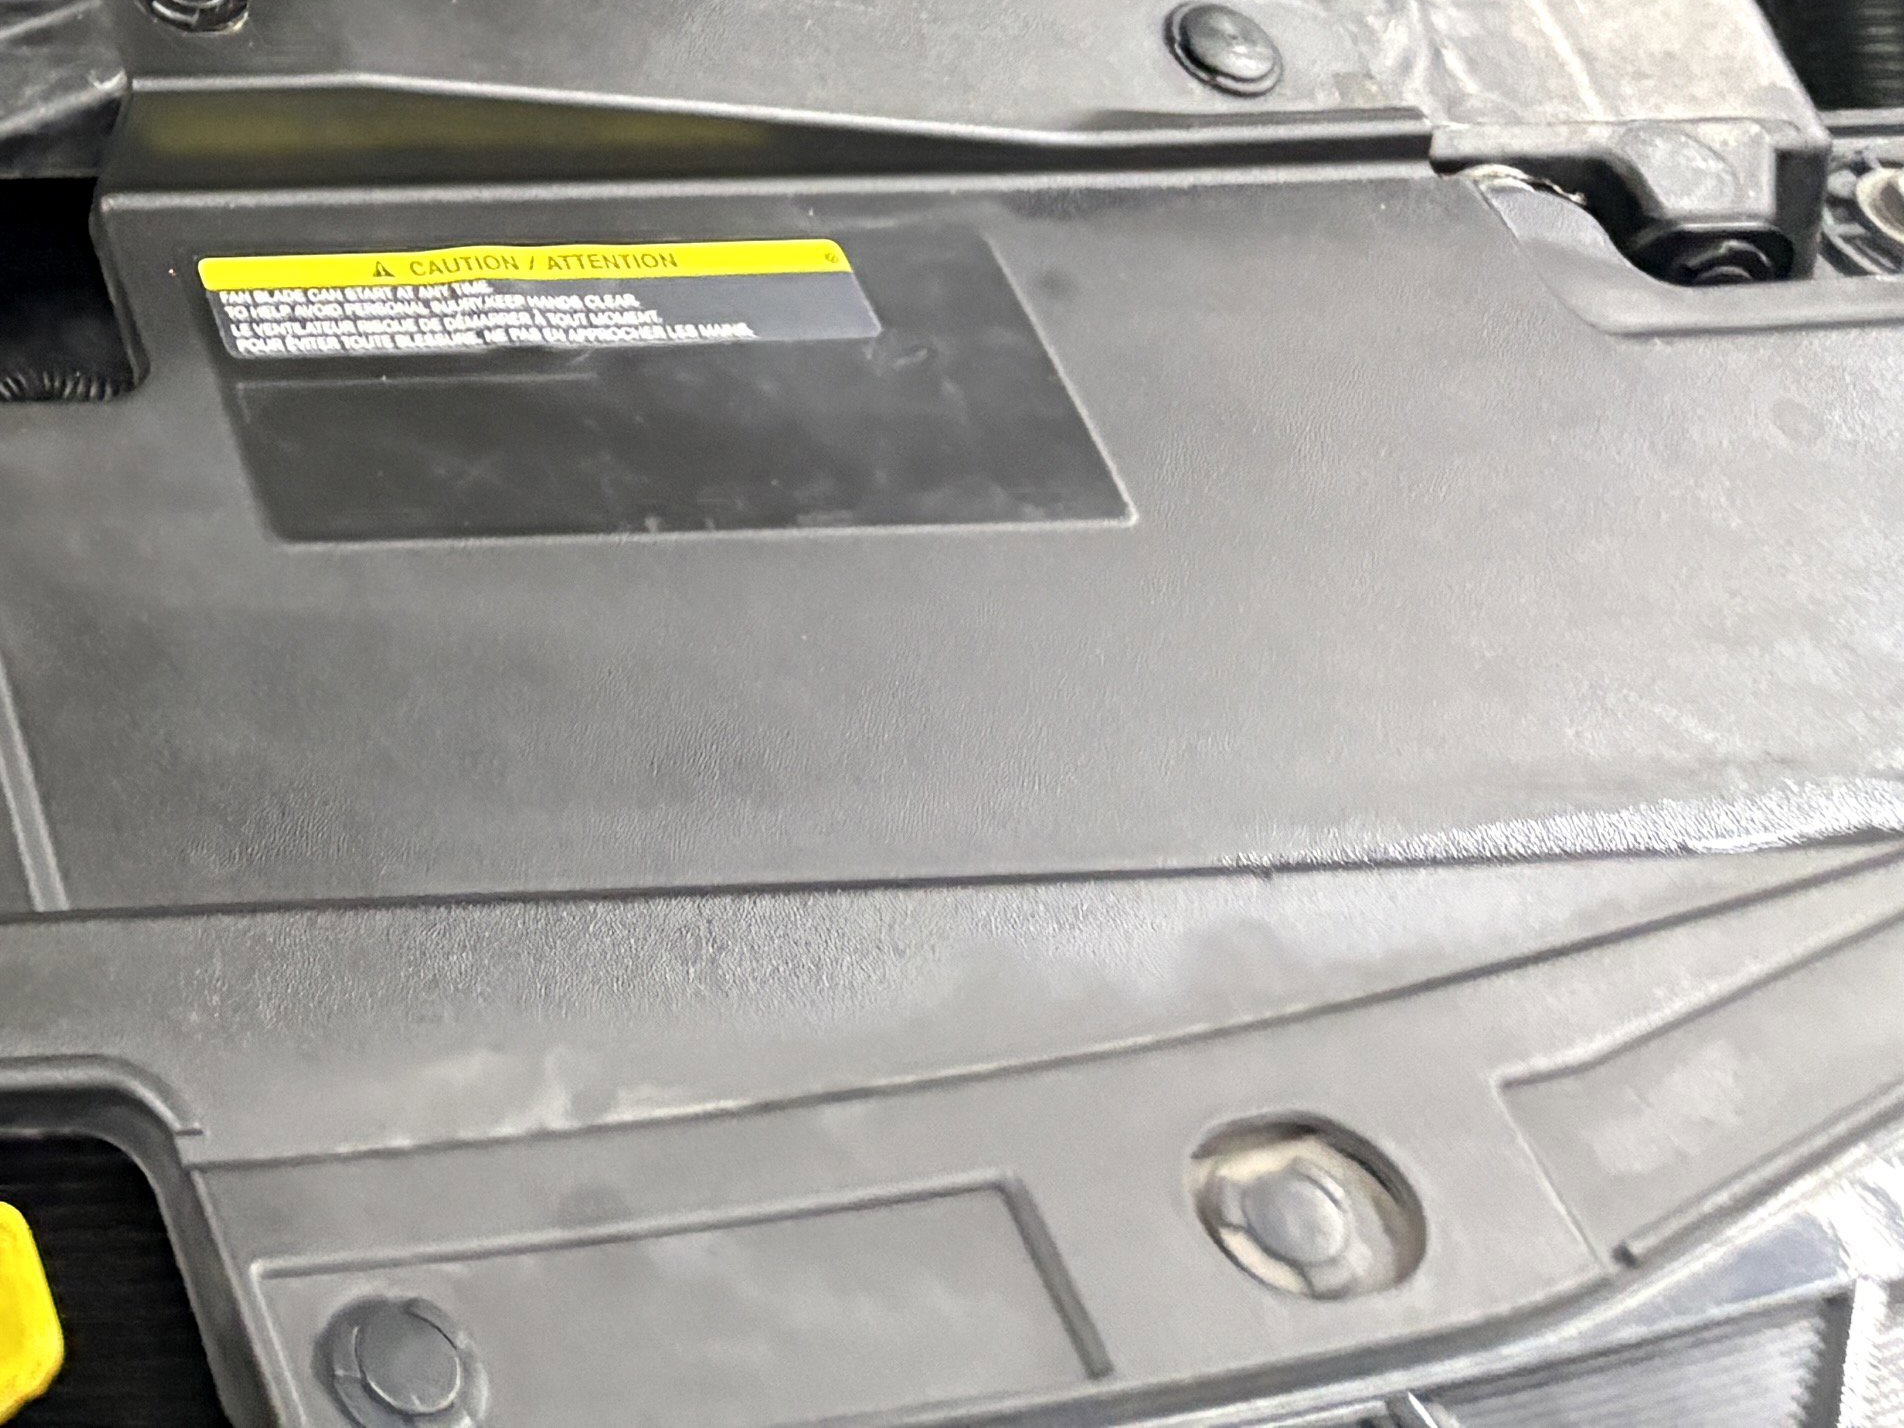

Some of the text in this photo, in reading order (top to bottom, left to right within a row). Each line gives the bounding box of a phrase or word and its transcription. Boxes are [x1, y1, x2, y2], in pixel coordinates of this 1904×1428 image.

[409, 253, 519, 277] CAUTION
[547, 251, 679, 271] ATTENTION
[219, 290, 252, 304] FAN
[253, 289, 306, 304] BLADE
[307, 287, 344, 303] CAN
[344, 286, 394, 302] START
[395, 285, 415, 299] AT
[418, 283, 449, 298] ANY
[224, 305, 249, 321] TO
[249, 304, 292, 320] HELP
[294, 302, 343, 318] AVOID
[230, 322, 253, 338] LE
[418, 317, 441, 333] DE
[545, 311, 588, 327] TOUT
